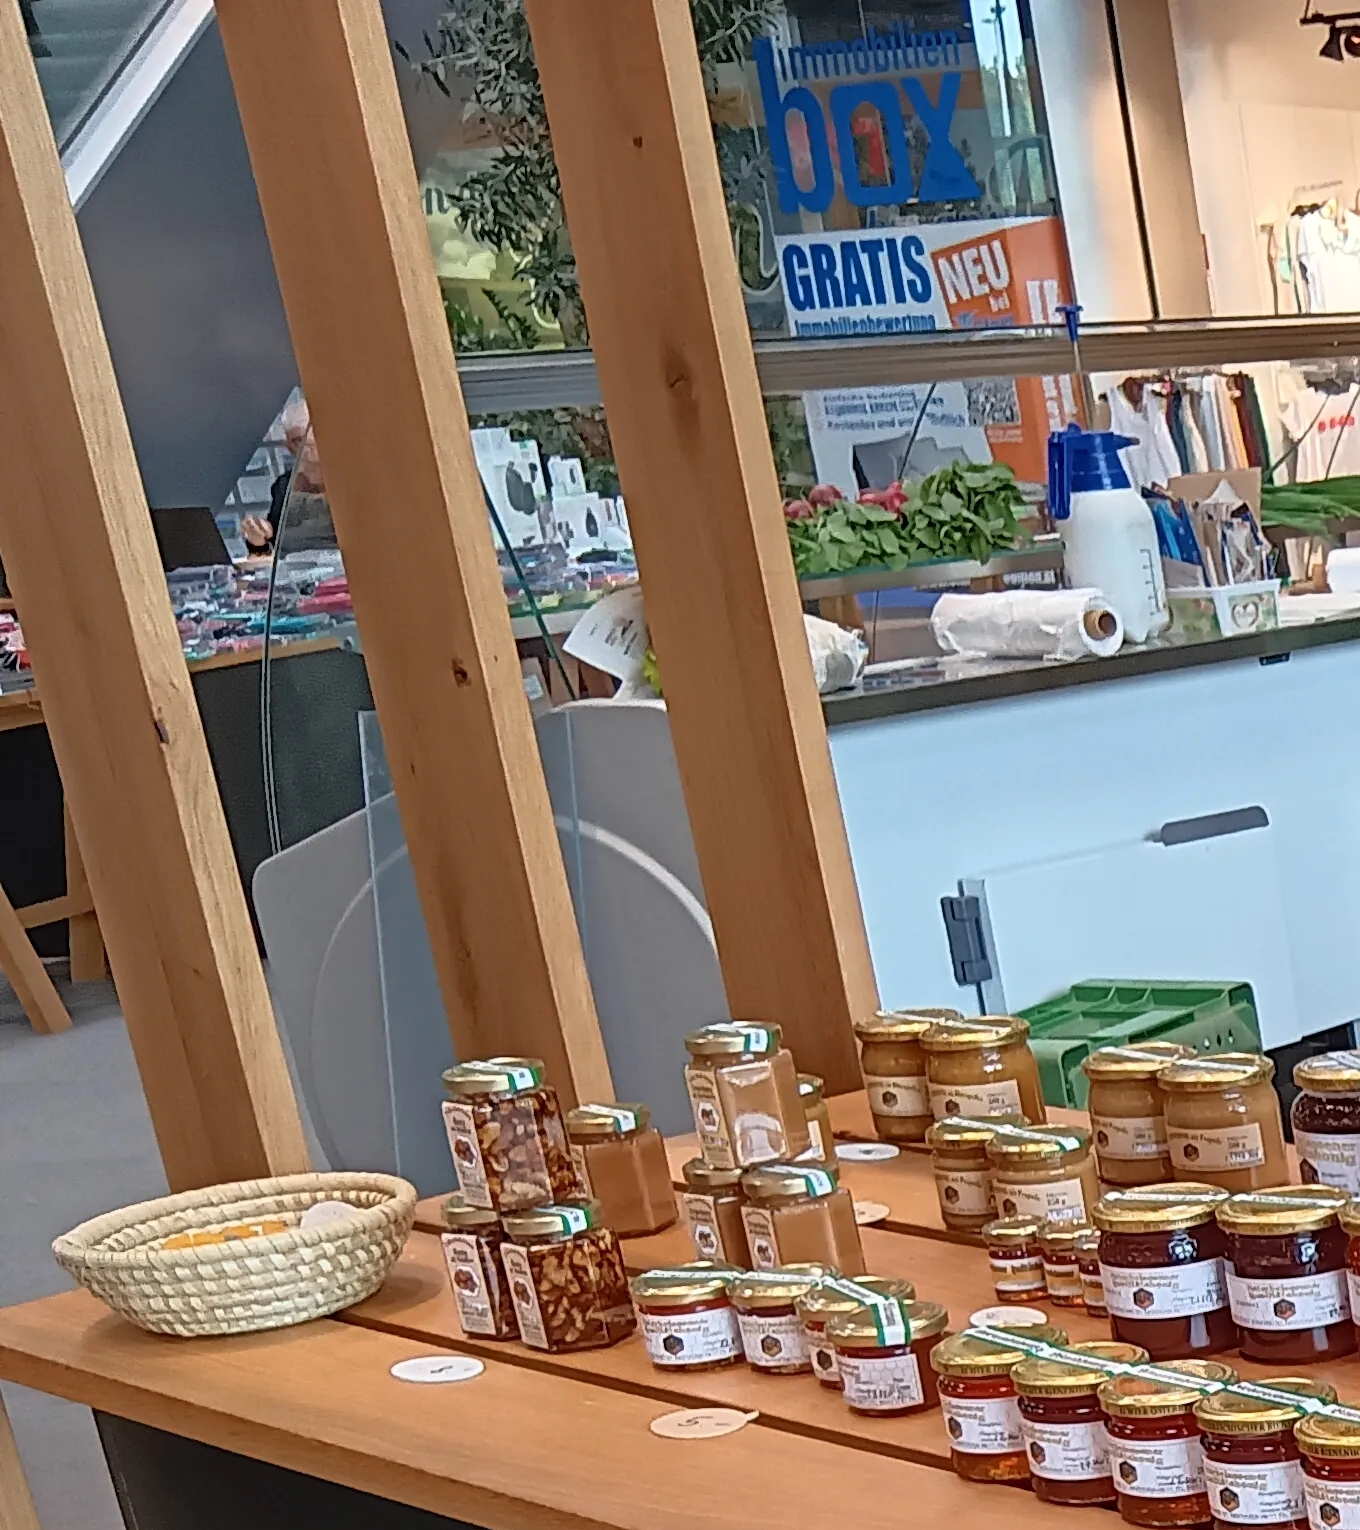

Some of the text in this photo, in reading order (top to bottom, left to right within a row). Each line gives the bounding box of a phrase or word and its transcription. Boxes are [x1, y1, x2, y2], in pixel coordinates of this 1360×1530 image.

[753, 37, 984, 214] box
[782, 235, 932, 311] GRATIS
[937, 240, 1010, 304] NEU
